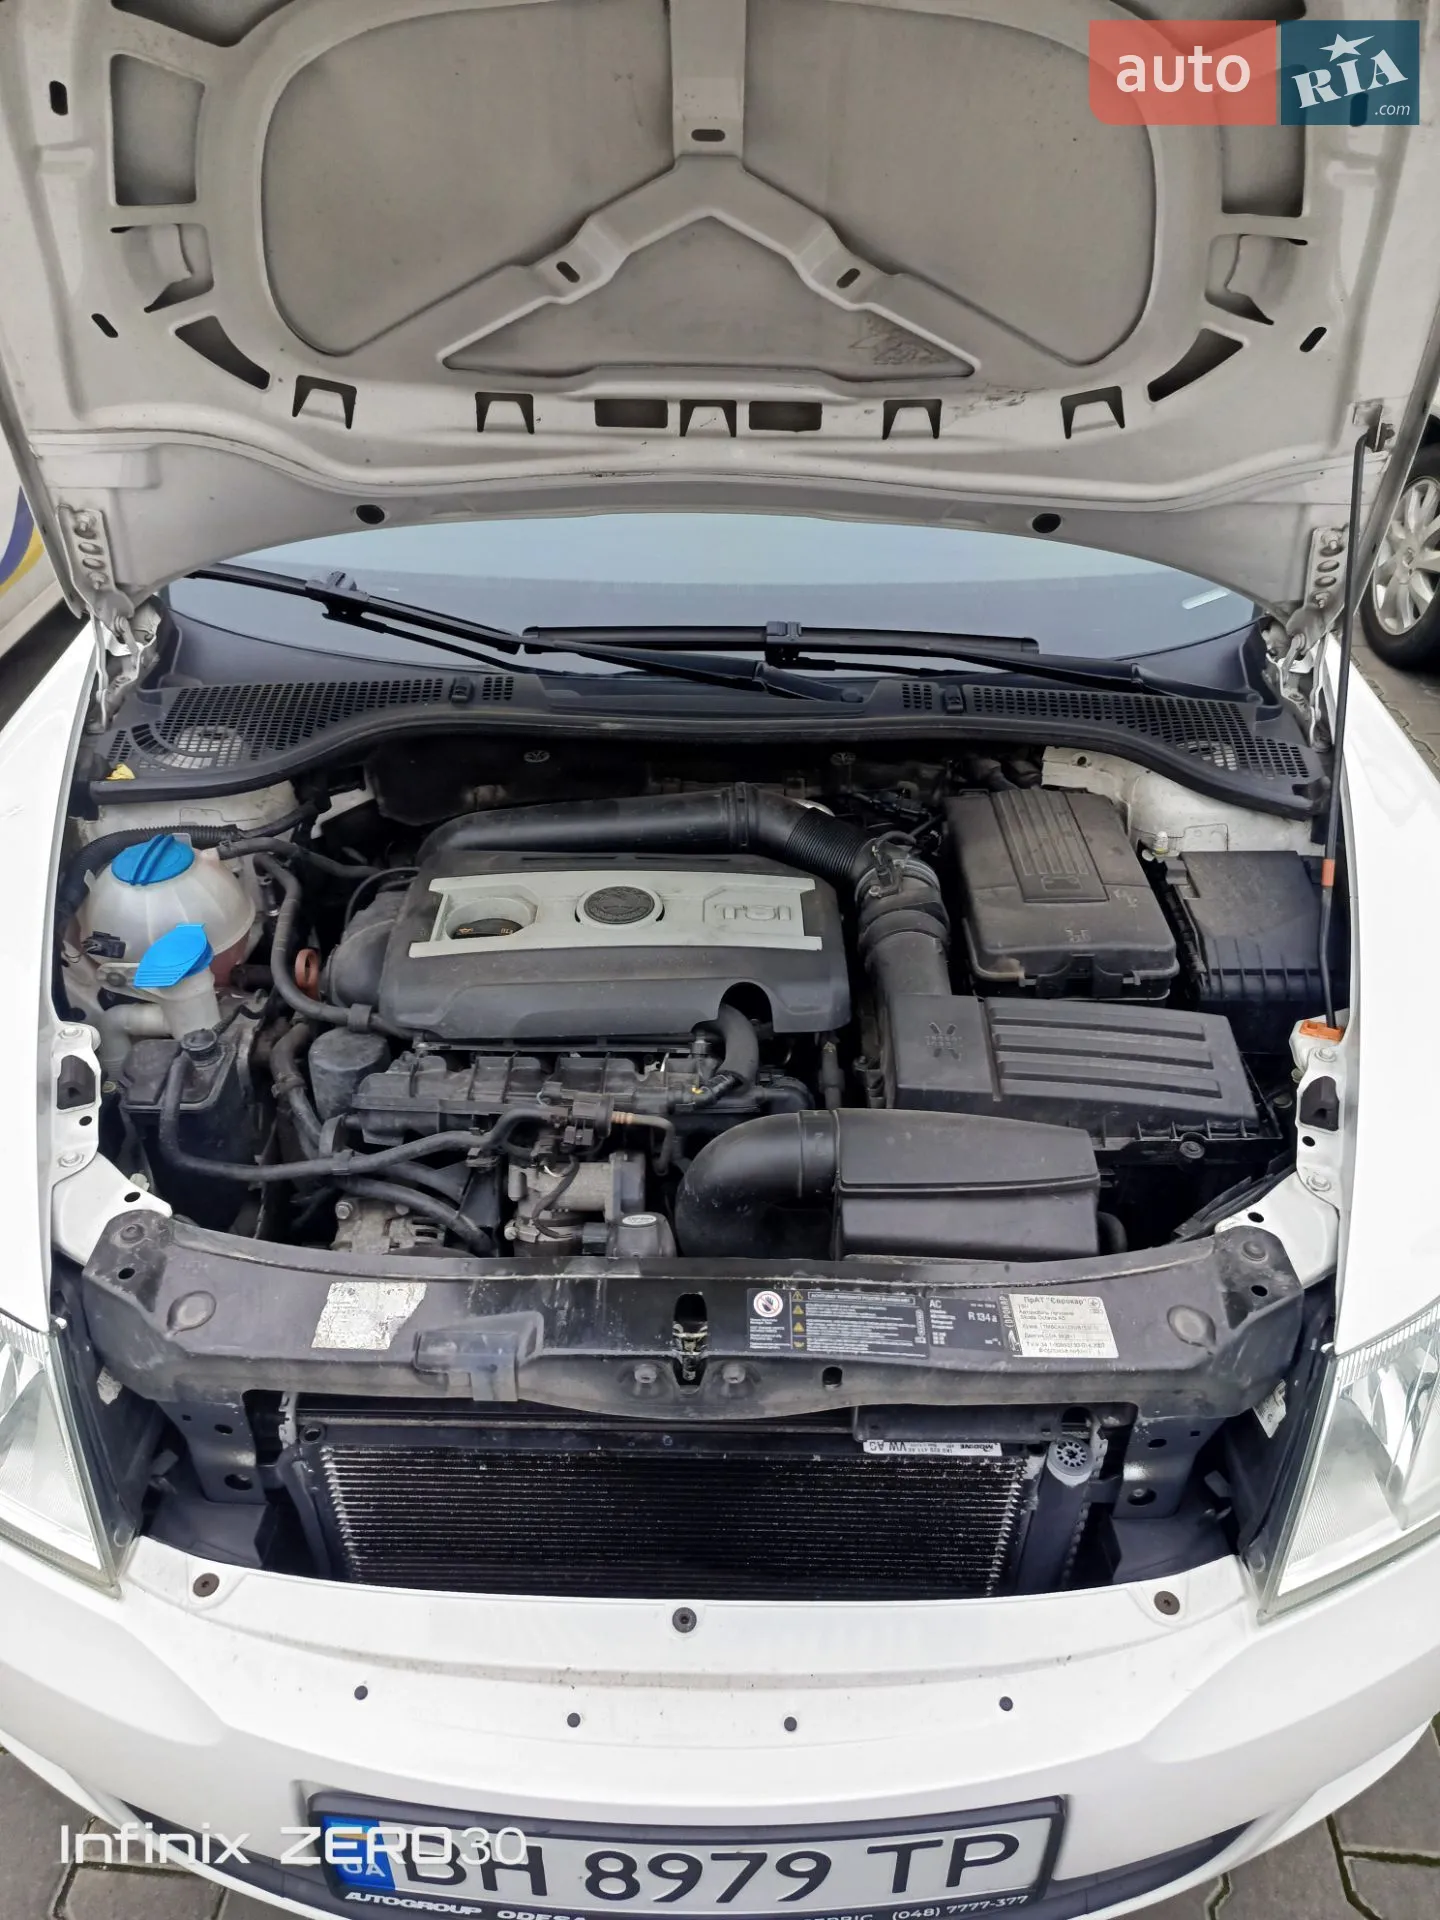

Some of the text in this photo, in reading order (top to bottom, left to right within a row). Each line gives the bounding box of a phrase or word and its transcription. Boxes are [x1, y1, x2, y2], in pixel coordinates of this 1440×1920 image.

[714, 903, 792, 921] TSI
[930, 1299, 942, 1309] AC
[889, 1441, 907, 1452] VW
[398, 1832, 1021, 1904] BH 8979 TP
[345, 1891, 483, 1915] AUTOGROUP
[892, 1895, 1029, 1920] (048) 7777-377
